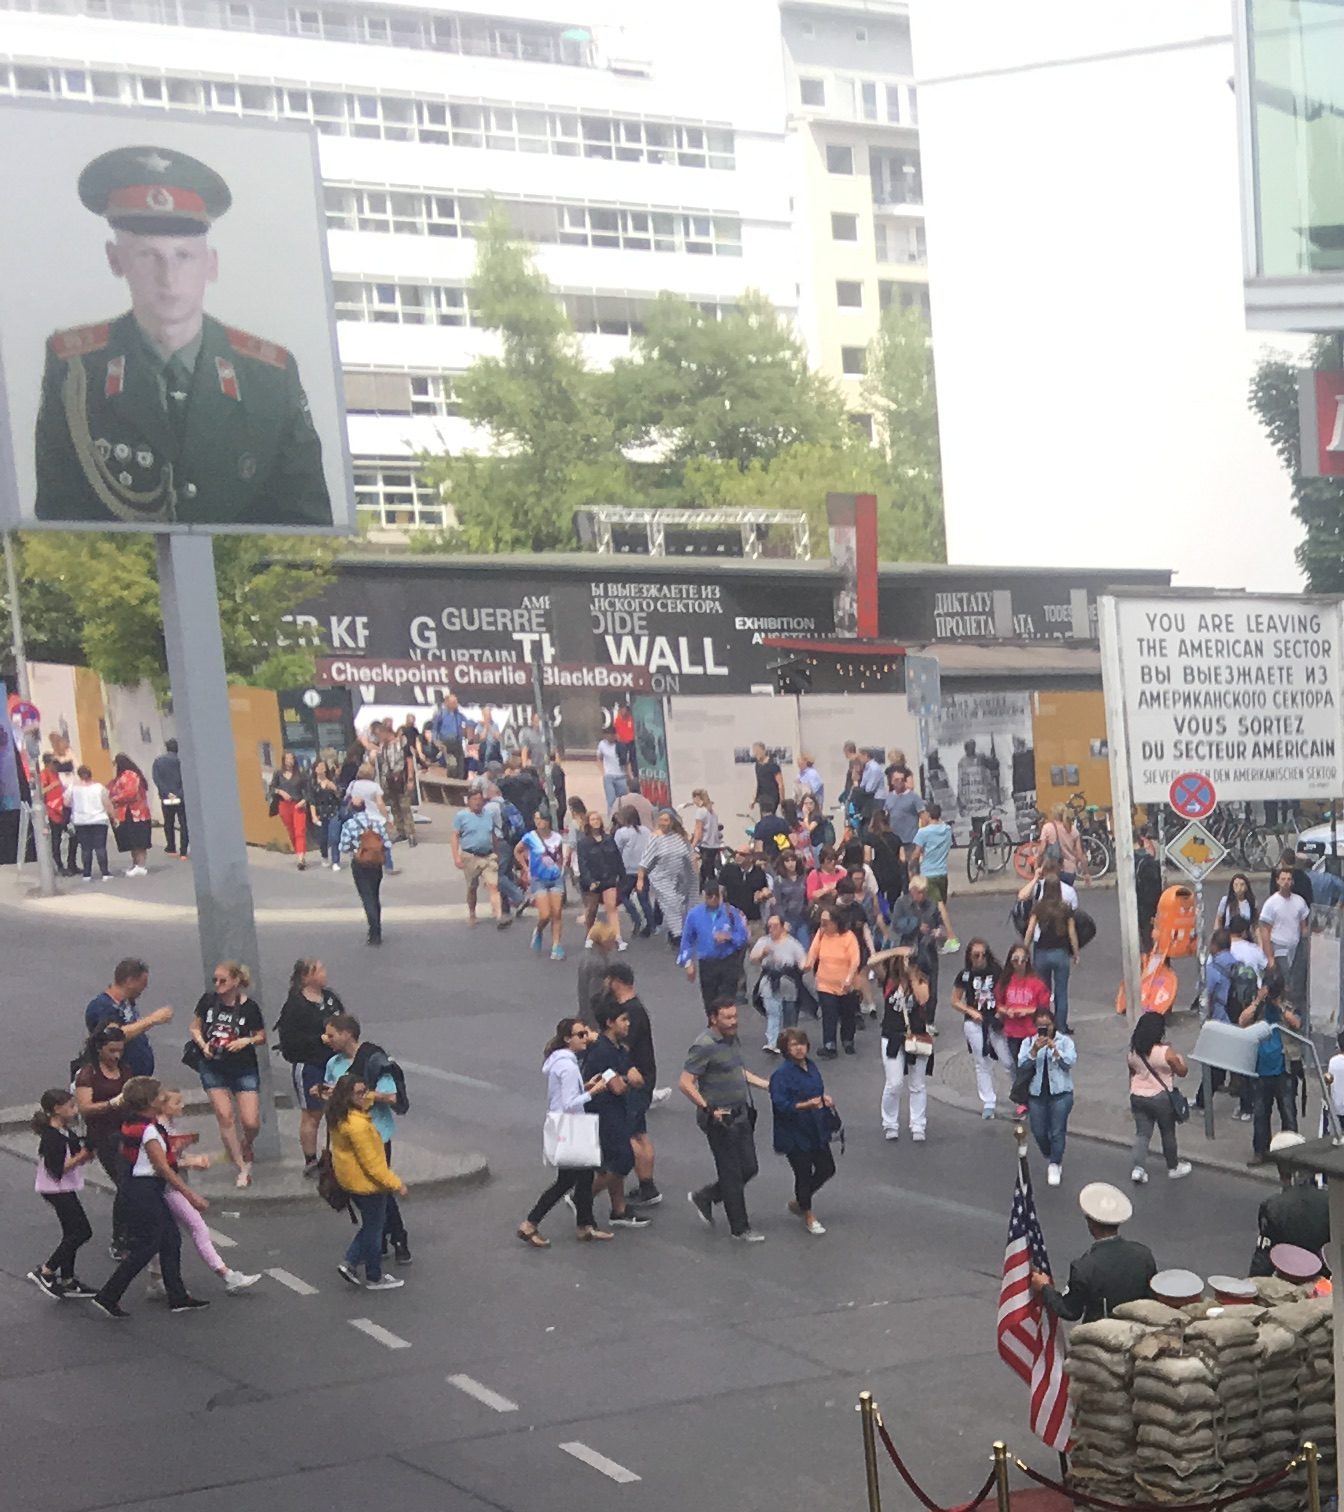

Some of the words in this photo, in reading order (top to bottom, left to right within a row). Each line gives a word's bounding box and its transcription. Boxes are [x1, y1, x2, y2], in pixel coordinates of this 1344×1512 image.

[607, 583, 699, 598] ВЫЕЗЖАЕТЕ
[701, 585, 720, 599] ИЗ
[657, 600, 723, 614] СЕКТОРА
[934, 592, 993, 616] ДИКТАТУ
[1043, 605, 1073, 622] TODES
[441, 607, 546, 632] GUERRE
[735, 616, 815, 630] EXHIBITION
[1145, 613, 1185, 633] YOU
[1198, 614, 1234, 633] ARE
[1247, 615, 1321, 634] LEAVING
[604, 634, 729, 676] WALL
[1137, 638, 1168, 658] THE
[1178, 639, 1264, 658] AMERICAN
[1274, 640, 1331, 658] SECTOR
[331, 662, 449, 686] Checkpoint
[454, 664, 526, 685] Charlie
[542, 666, 633, 689] BlackBox
[1141, 665, 1171, 684] ВЫ
[1183, 665, 1294, 685] ВЫЕЗЖАЕТЕ
[1305, 666, 1328, 684] ИЗ
[1138, 690, 1266, 709] АМЕРИКАНСКОГО
[1273, 690, 1334, 709] СЕКТОРА
[1174, 716, 1226, 735] VOUS
[1239, 715, 1304, 735] SORTEZ
[1142, 742, 1164, 760] DU
[1173, 741, 1246, 760] SECTEUR
[1213, 768, 1230, 783] DEN
[1233, 767, 1303, 783] AMERIKANISCHEN
[1307, 766, 1336, 781] SEKTOR
